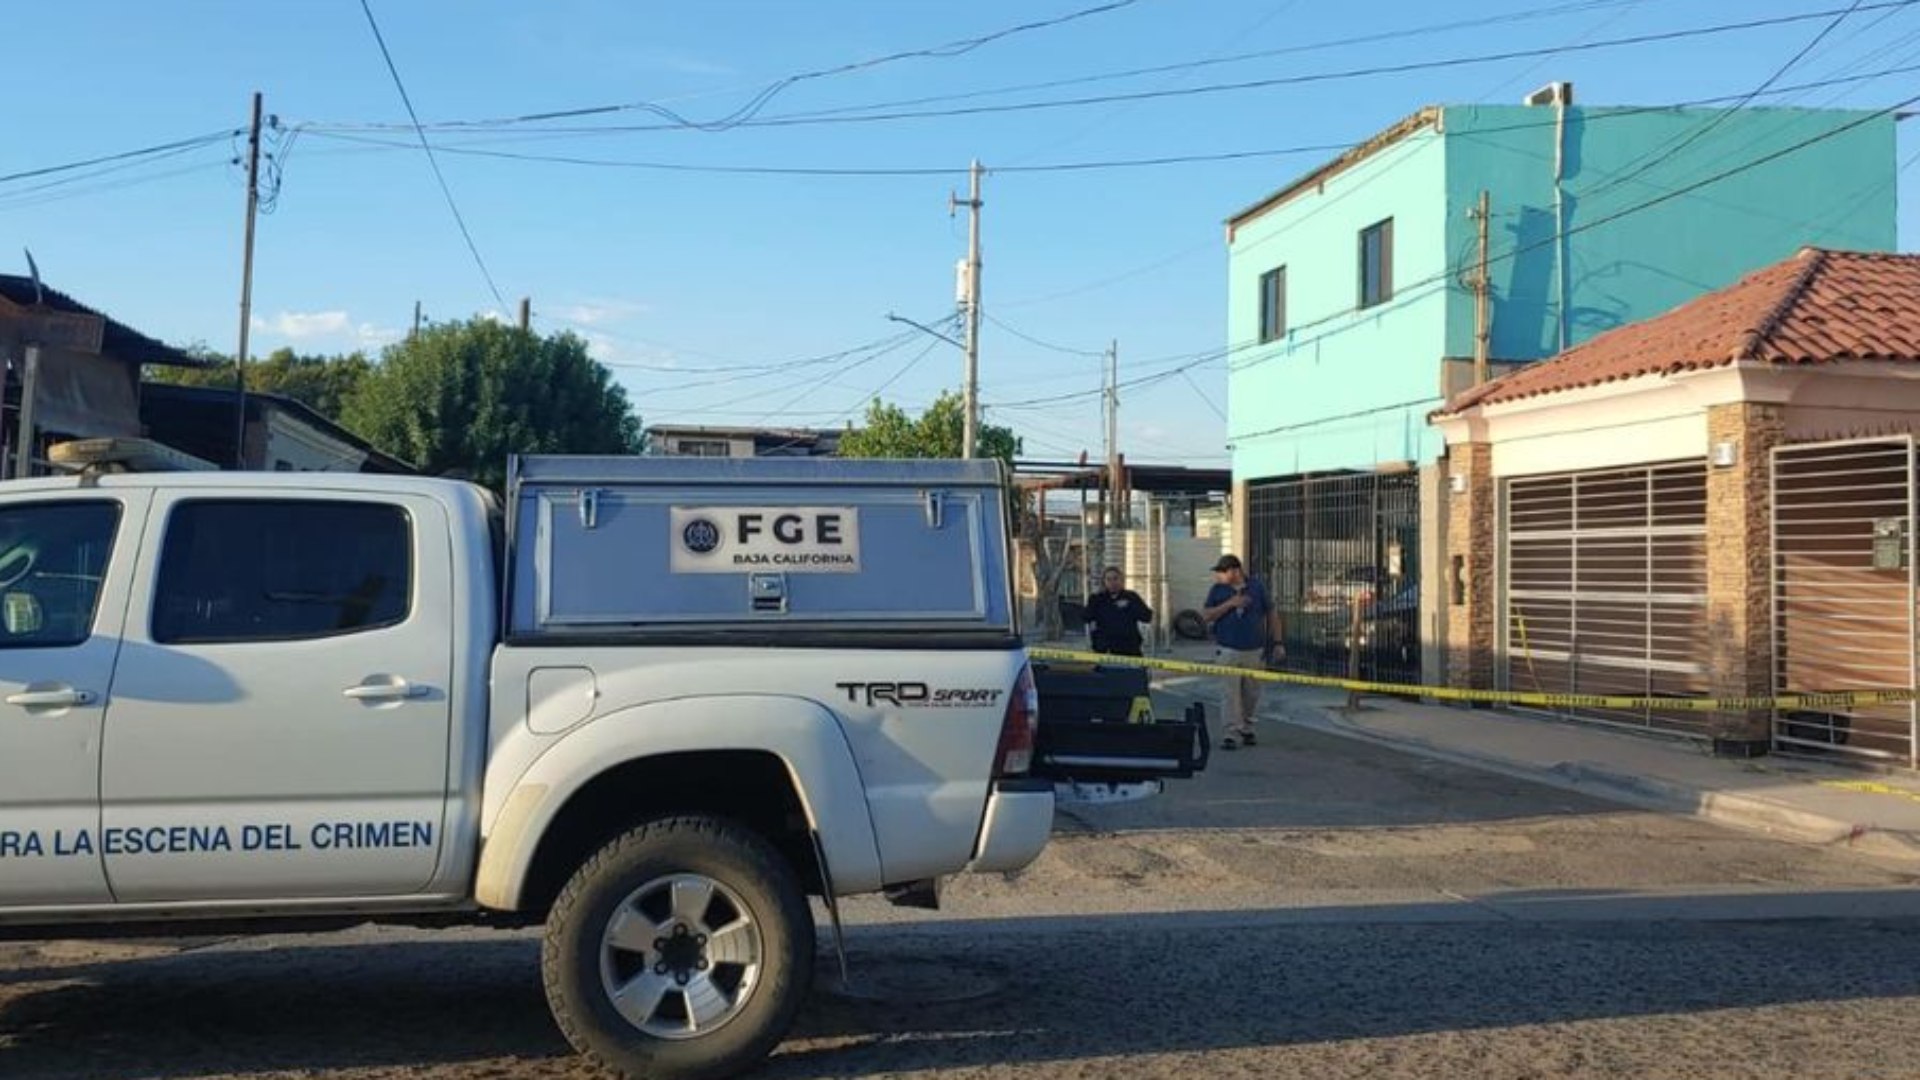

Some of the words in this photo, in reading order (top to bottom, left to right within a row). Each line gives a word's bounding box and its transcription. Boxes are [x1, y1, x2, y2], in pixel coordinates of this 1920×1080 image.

[737, 514, 843, 545] FGE
[733, 553, 769, 565] BAJA
[772, 553, 855, 566] CALIFORNIA
[835, 682, 929, 708] TRD
[932, 689, 1004, 702] SPORT
[0, 831, 44, 858] RA
[54, 829, 94, 856] LA
[104, 826, 232, 855] ESCENA
[242, 824, 302, 851] DEL
[311, 822, 432, 850] CRIMEN
